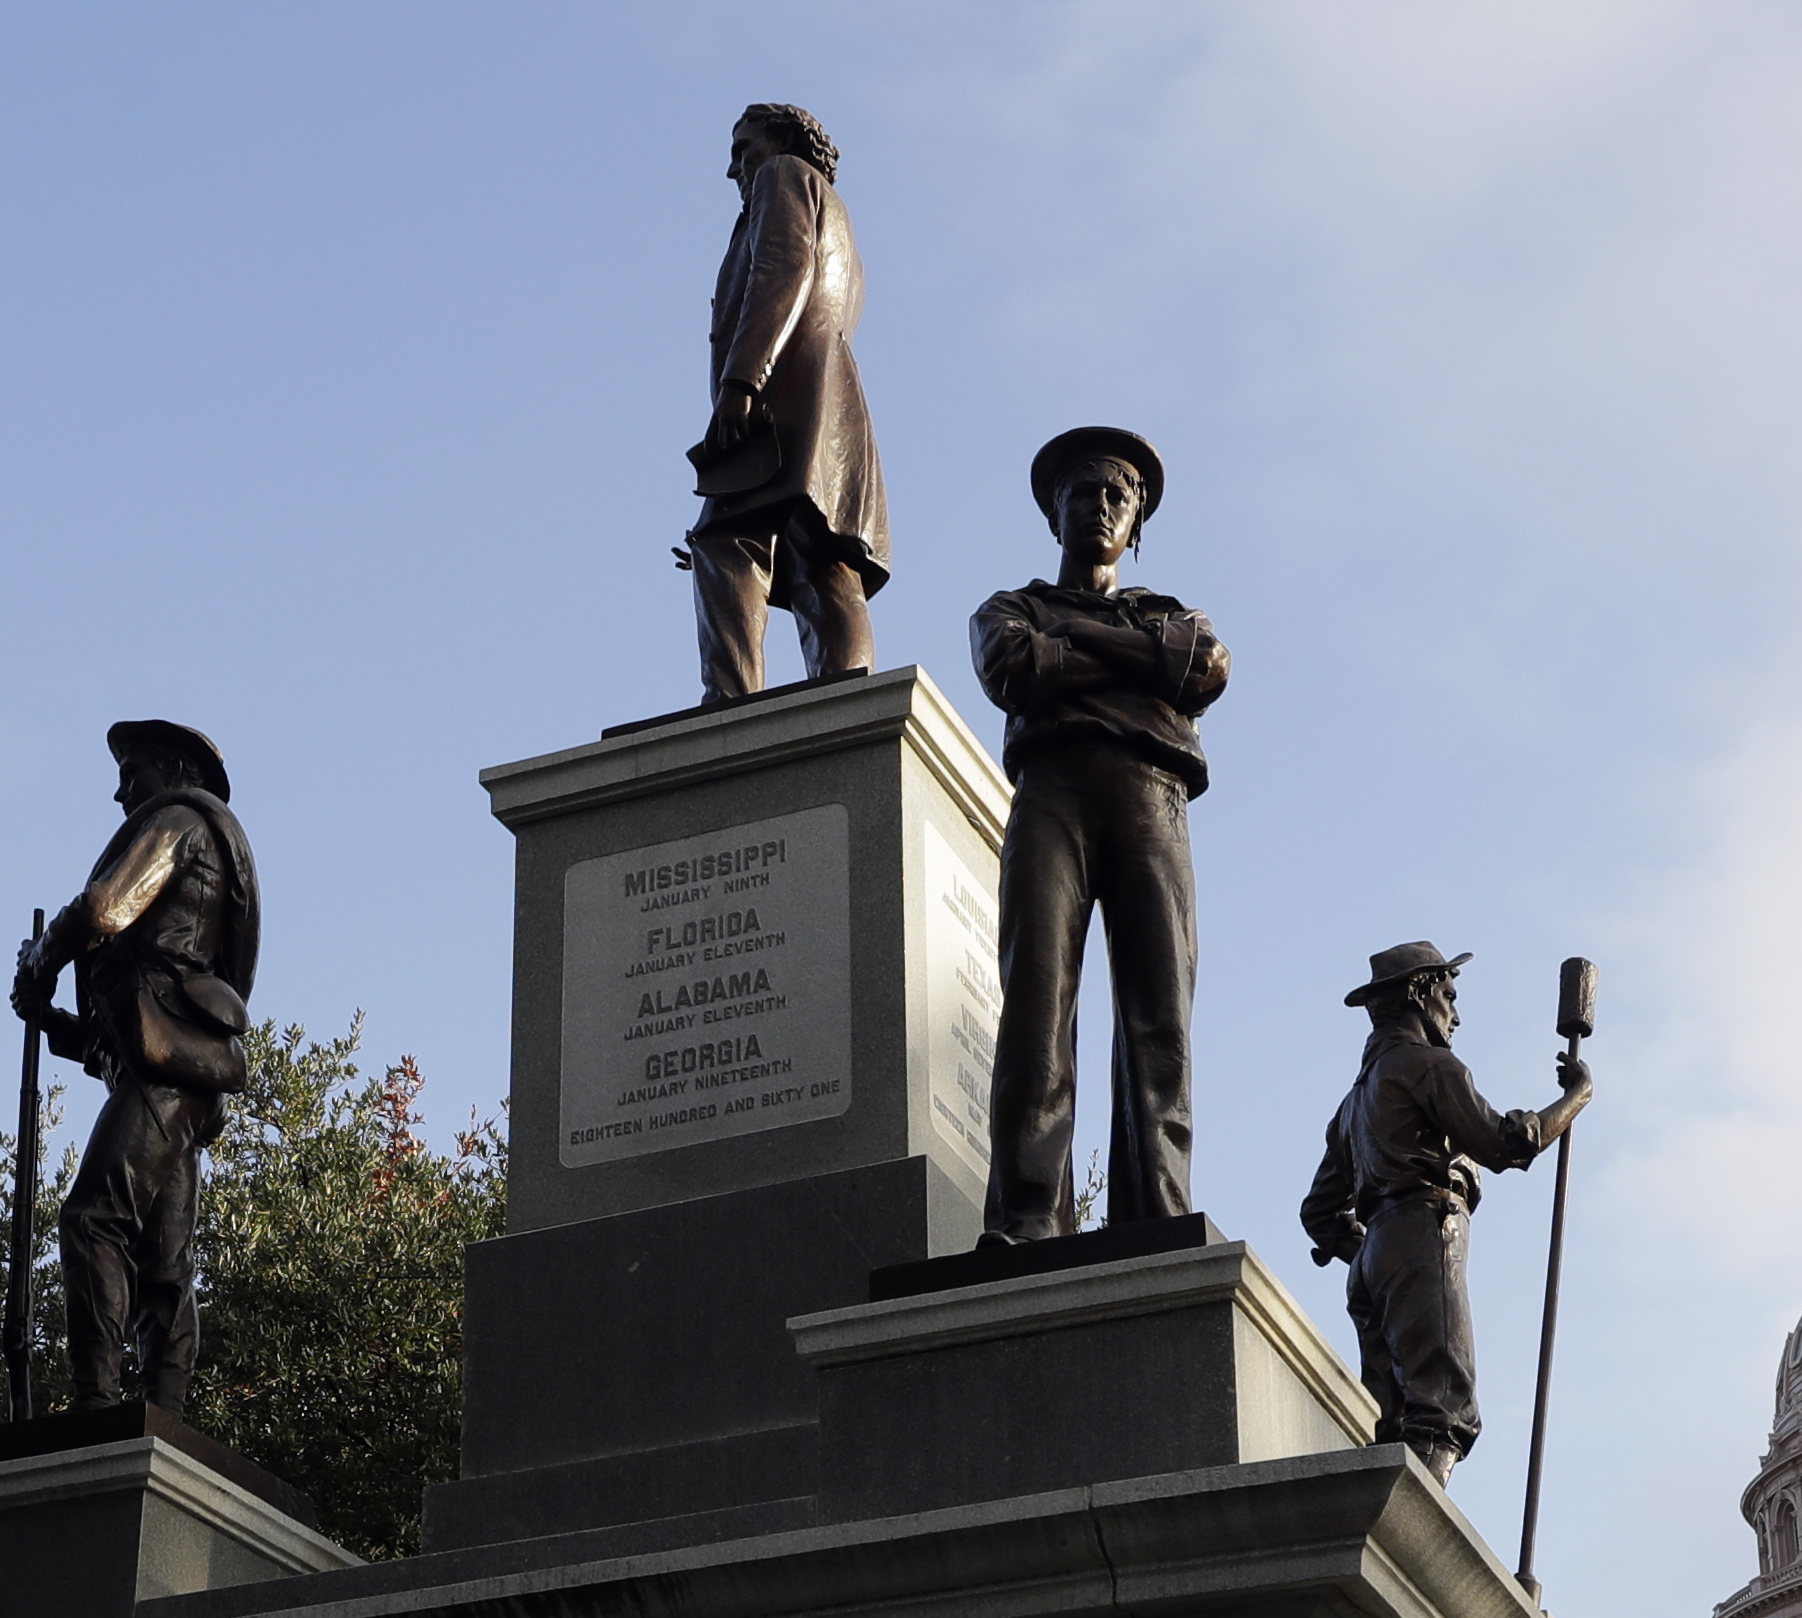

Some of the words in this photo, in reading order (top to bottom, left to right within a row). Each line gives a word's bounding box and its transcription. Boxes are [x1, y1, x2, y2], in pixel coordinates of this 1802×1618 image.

[625, 839, 786, 898] MISSISSIPPI
[640, 886, 710, 912] JANUARY
[724, 874, 770, 894] NINTH
[954, 874, 998, 947] LOUISIA
[648, 908, 761, 954] FLORIDA
[625, 952, 696, 978] JANUARY
[703, 932, 786, 962] ELEVENTH
[637, 968, 771, 1018] ALABAMA
[965, 948, 1000, 1010] TEXAS
[624, 1014, 696, 1041] JANUARY
[703, 996, 786, 1024] ELEVENTH
[645, 1034, 762, 1080] GEORGIA
[617, 1080, 688, 1106] JANUARY
[695, 1059, 792, 1091] NINETEENTH
[570, 1120, 642, 1145] EIGHTEEN
[649, 1104, 717, 1129] HUNDRED
[724, 1097, 754, 1114] AND
[761, 1086, 804, 1108] SIXTY
[810, 1079, 840, 1099] ONE
